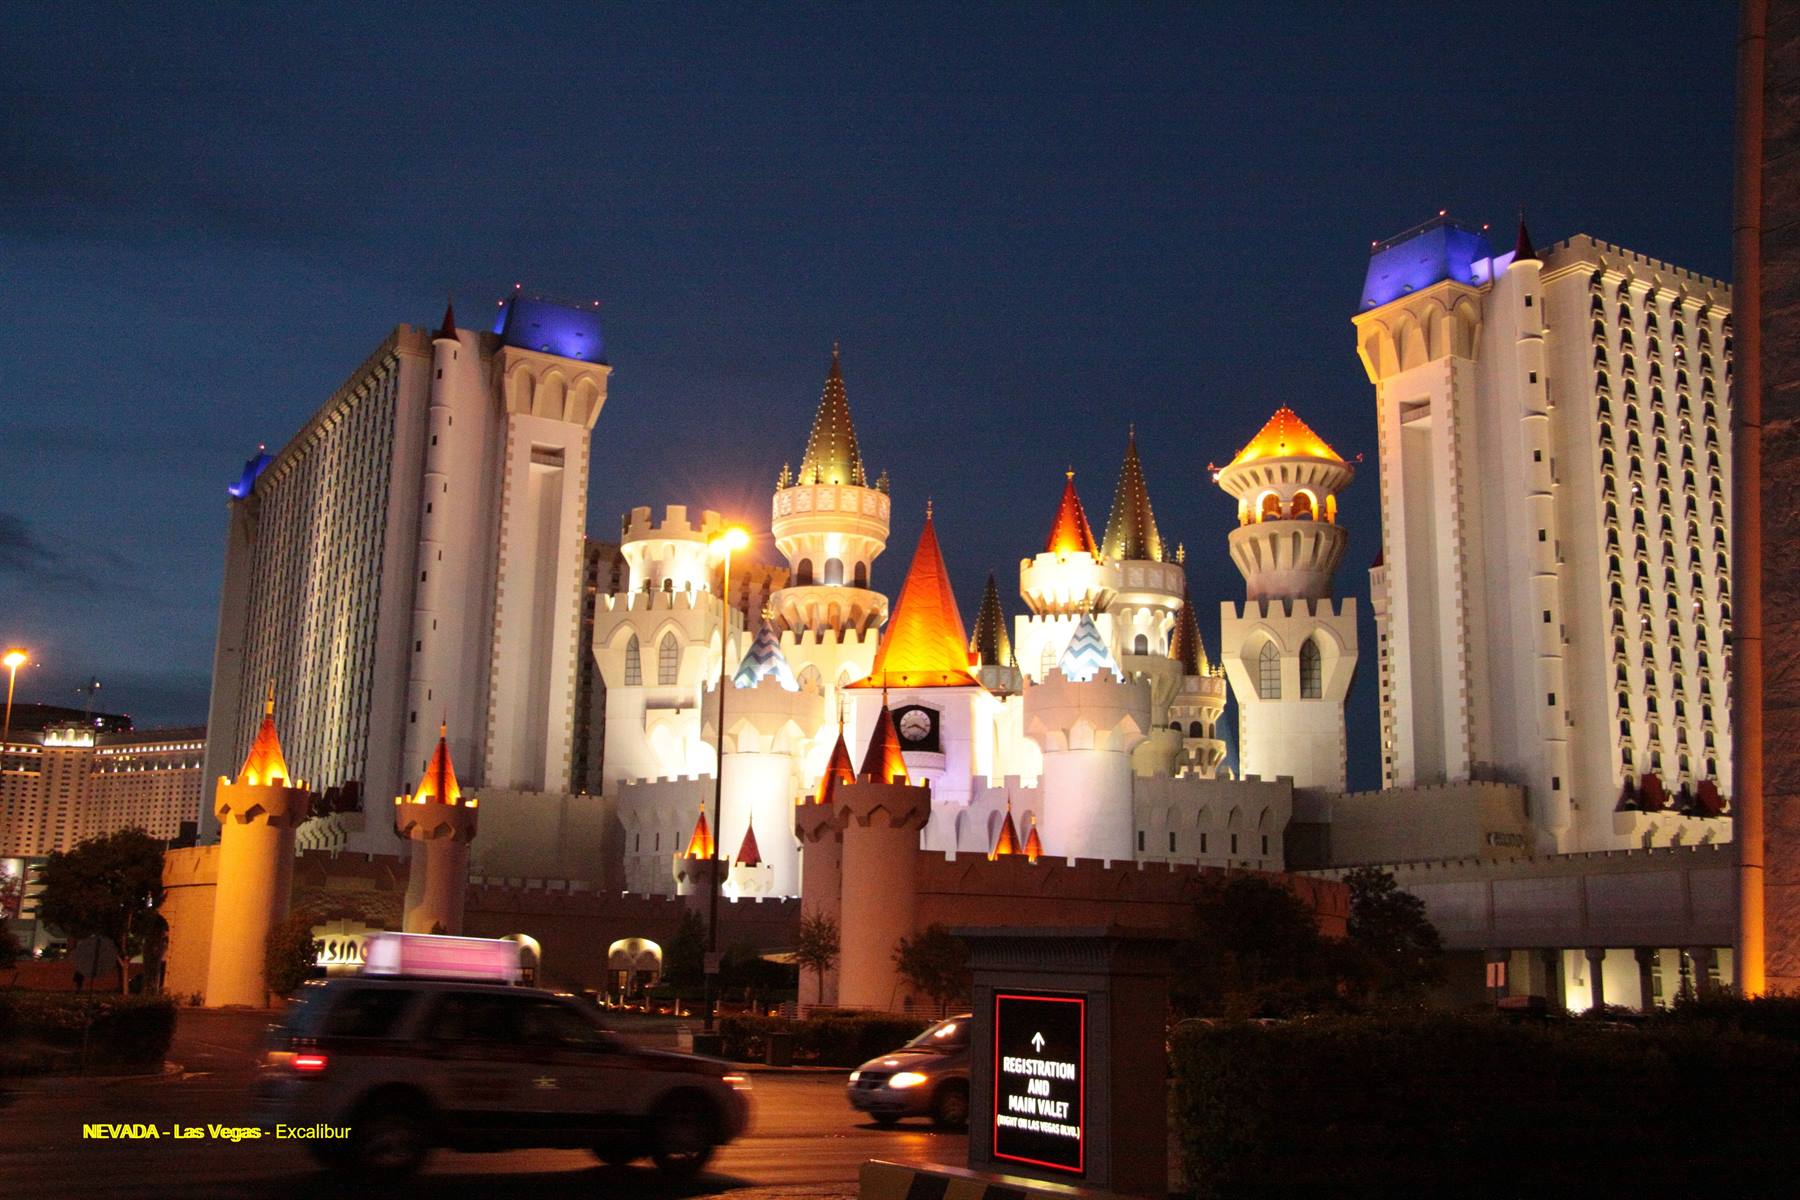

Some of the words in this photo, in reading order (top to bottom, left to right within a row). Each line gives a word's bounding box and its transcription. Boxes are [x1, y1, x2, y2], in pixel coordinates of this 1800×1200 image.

[1003, 1056, 1075, 1080] REGISTRATION
[1027, 1078, 1050, 1096] AND
[1008, 1095, 1036, 1115] MAIN
[1037, 1098, 1069, 1119] VALET
[1028, 1119, 1040, 1132] LAS
[1040, 1120, 1060, 1135] VEGAS
